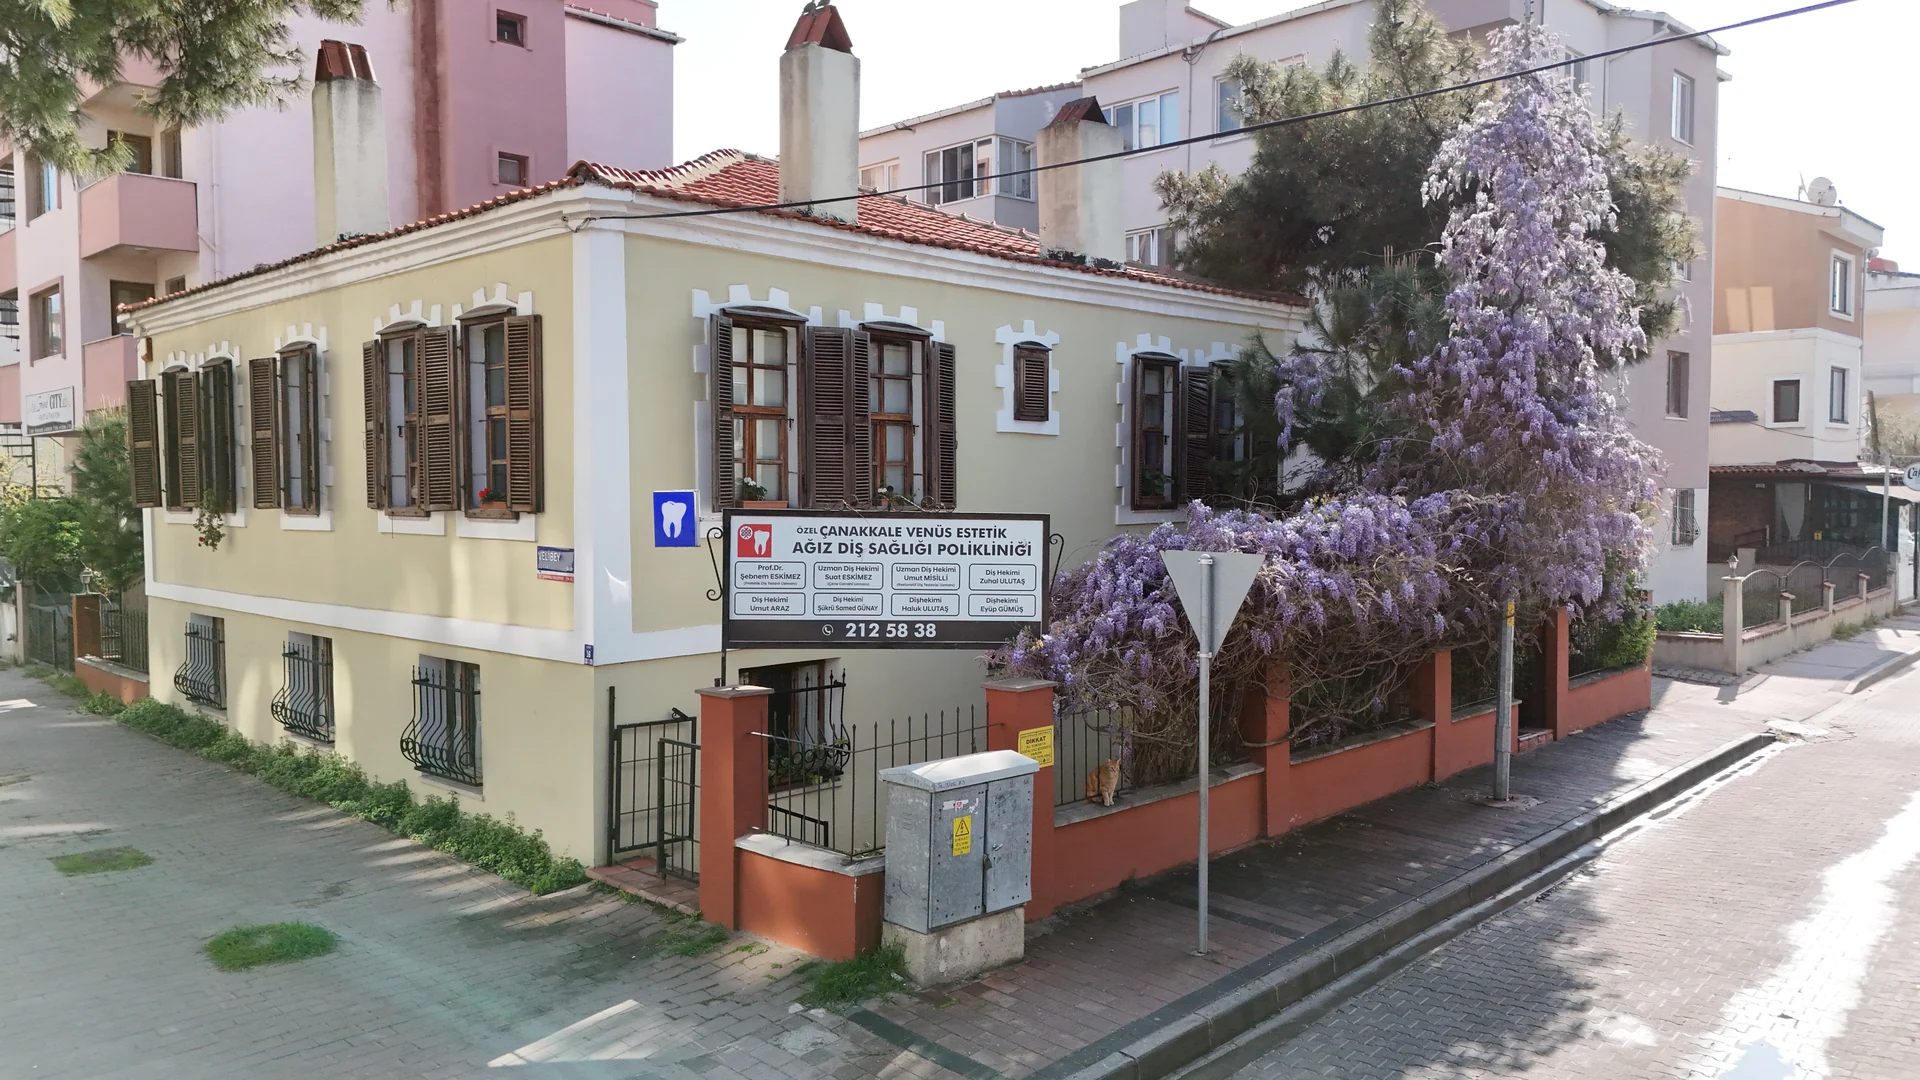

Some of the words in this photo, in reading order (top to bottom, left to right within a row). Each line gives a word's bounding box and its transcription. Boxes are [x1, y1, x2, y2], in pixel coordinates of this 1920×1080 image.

[50, 393, 62, 409] CITY
[796, 525, 818, 535] ÖZEL
[820, 525, 902, 539] ÇANAKKALE
[906, 524, 952, 538] VENÜS
[956, 525, 1007, 539] ESTETİK
[792, 539, 832, 555] AĞIZ
[838, 540, 864, 557] DİŞ
[868, 540, 932, 556] SAĞLIĞI
[938, 541, 1032, 557] POLİKLİNİĞİ
[844, 565, 854, 573] Diş
[921, 566, 931, 574] Diş
[985, 569, 996, 577] Diş
[740, 573, 769, 581] Şebnem
[751, 596, 763, 604] Diş
[833, 596, 843, 604] Diş
[986, 597, 1019, 605] Dişhekimi
[857, 604, 878, 612] GÜNAY
[922, 605, 949, 613] ULUTAŞ
[980, 605, 997, 613] Eyüp
[998, 605, 1024, 613] GÜMÜŞ
[845, 622, 880, 638] 212
[886, 623, 908, 638] 58
[914, 623, 937, 638] 38
